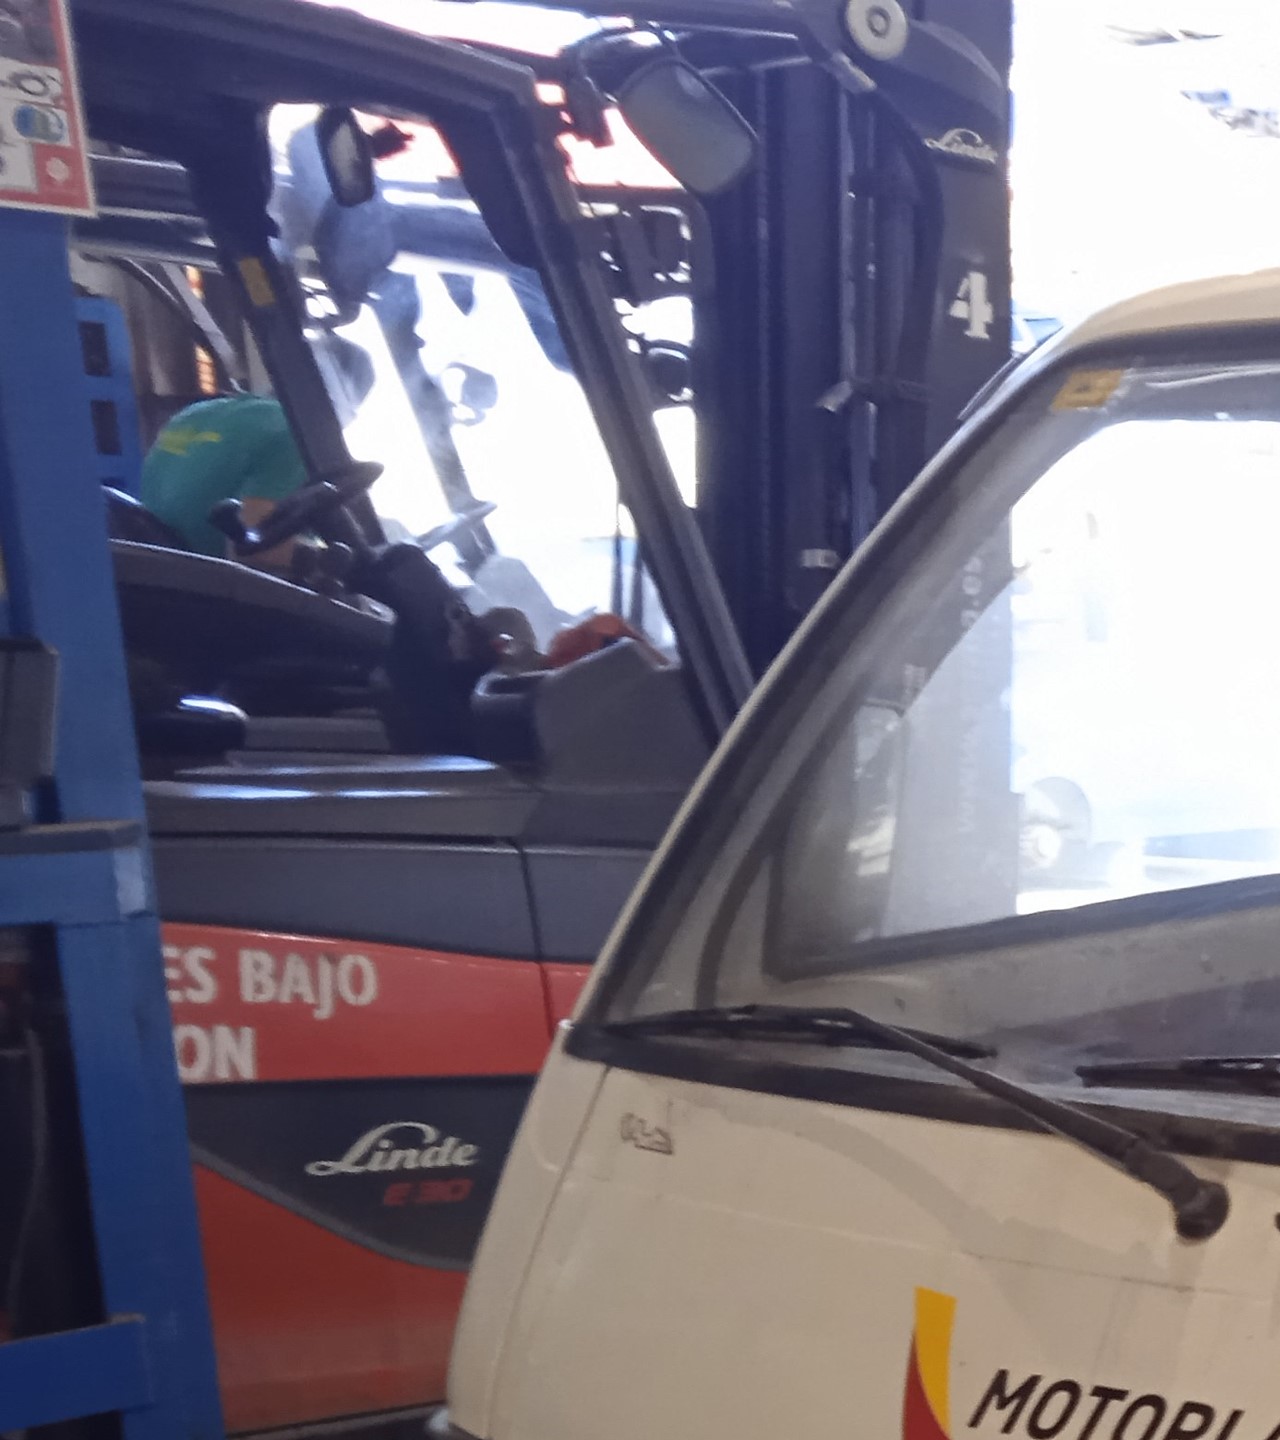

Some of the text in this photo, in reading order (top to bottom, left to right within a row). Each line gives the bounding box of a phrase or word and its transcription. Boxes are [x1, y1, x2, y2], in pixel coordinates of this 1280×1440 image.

[949, 270, 994, 340] 4
[238, 948, 379, 1021] BAJO
[304, 1120, 481, 1177] Linde
